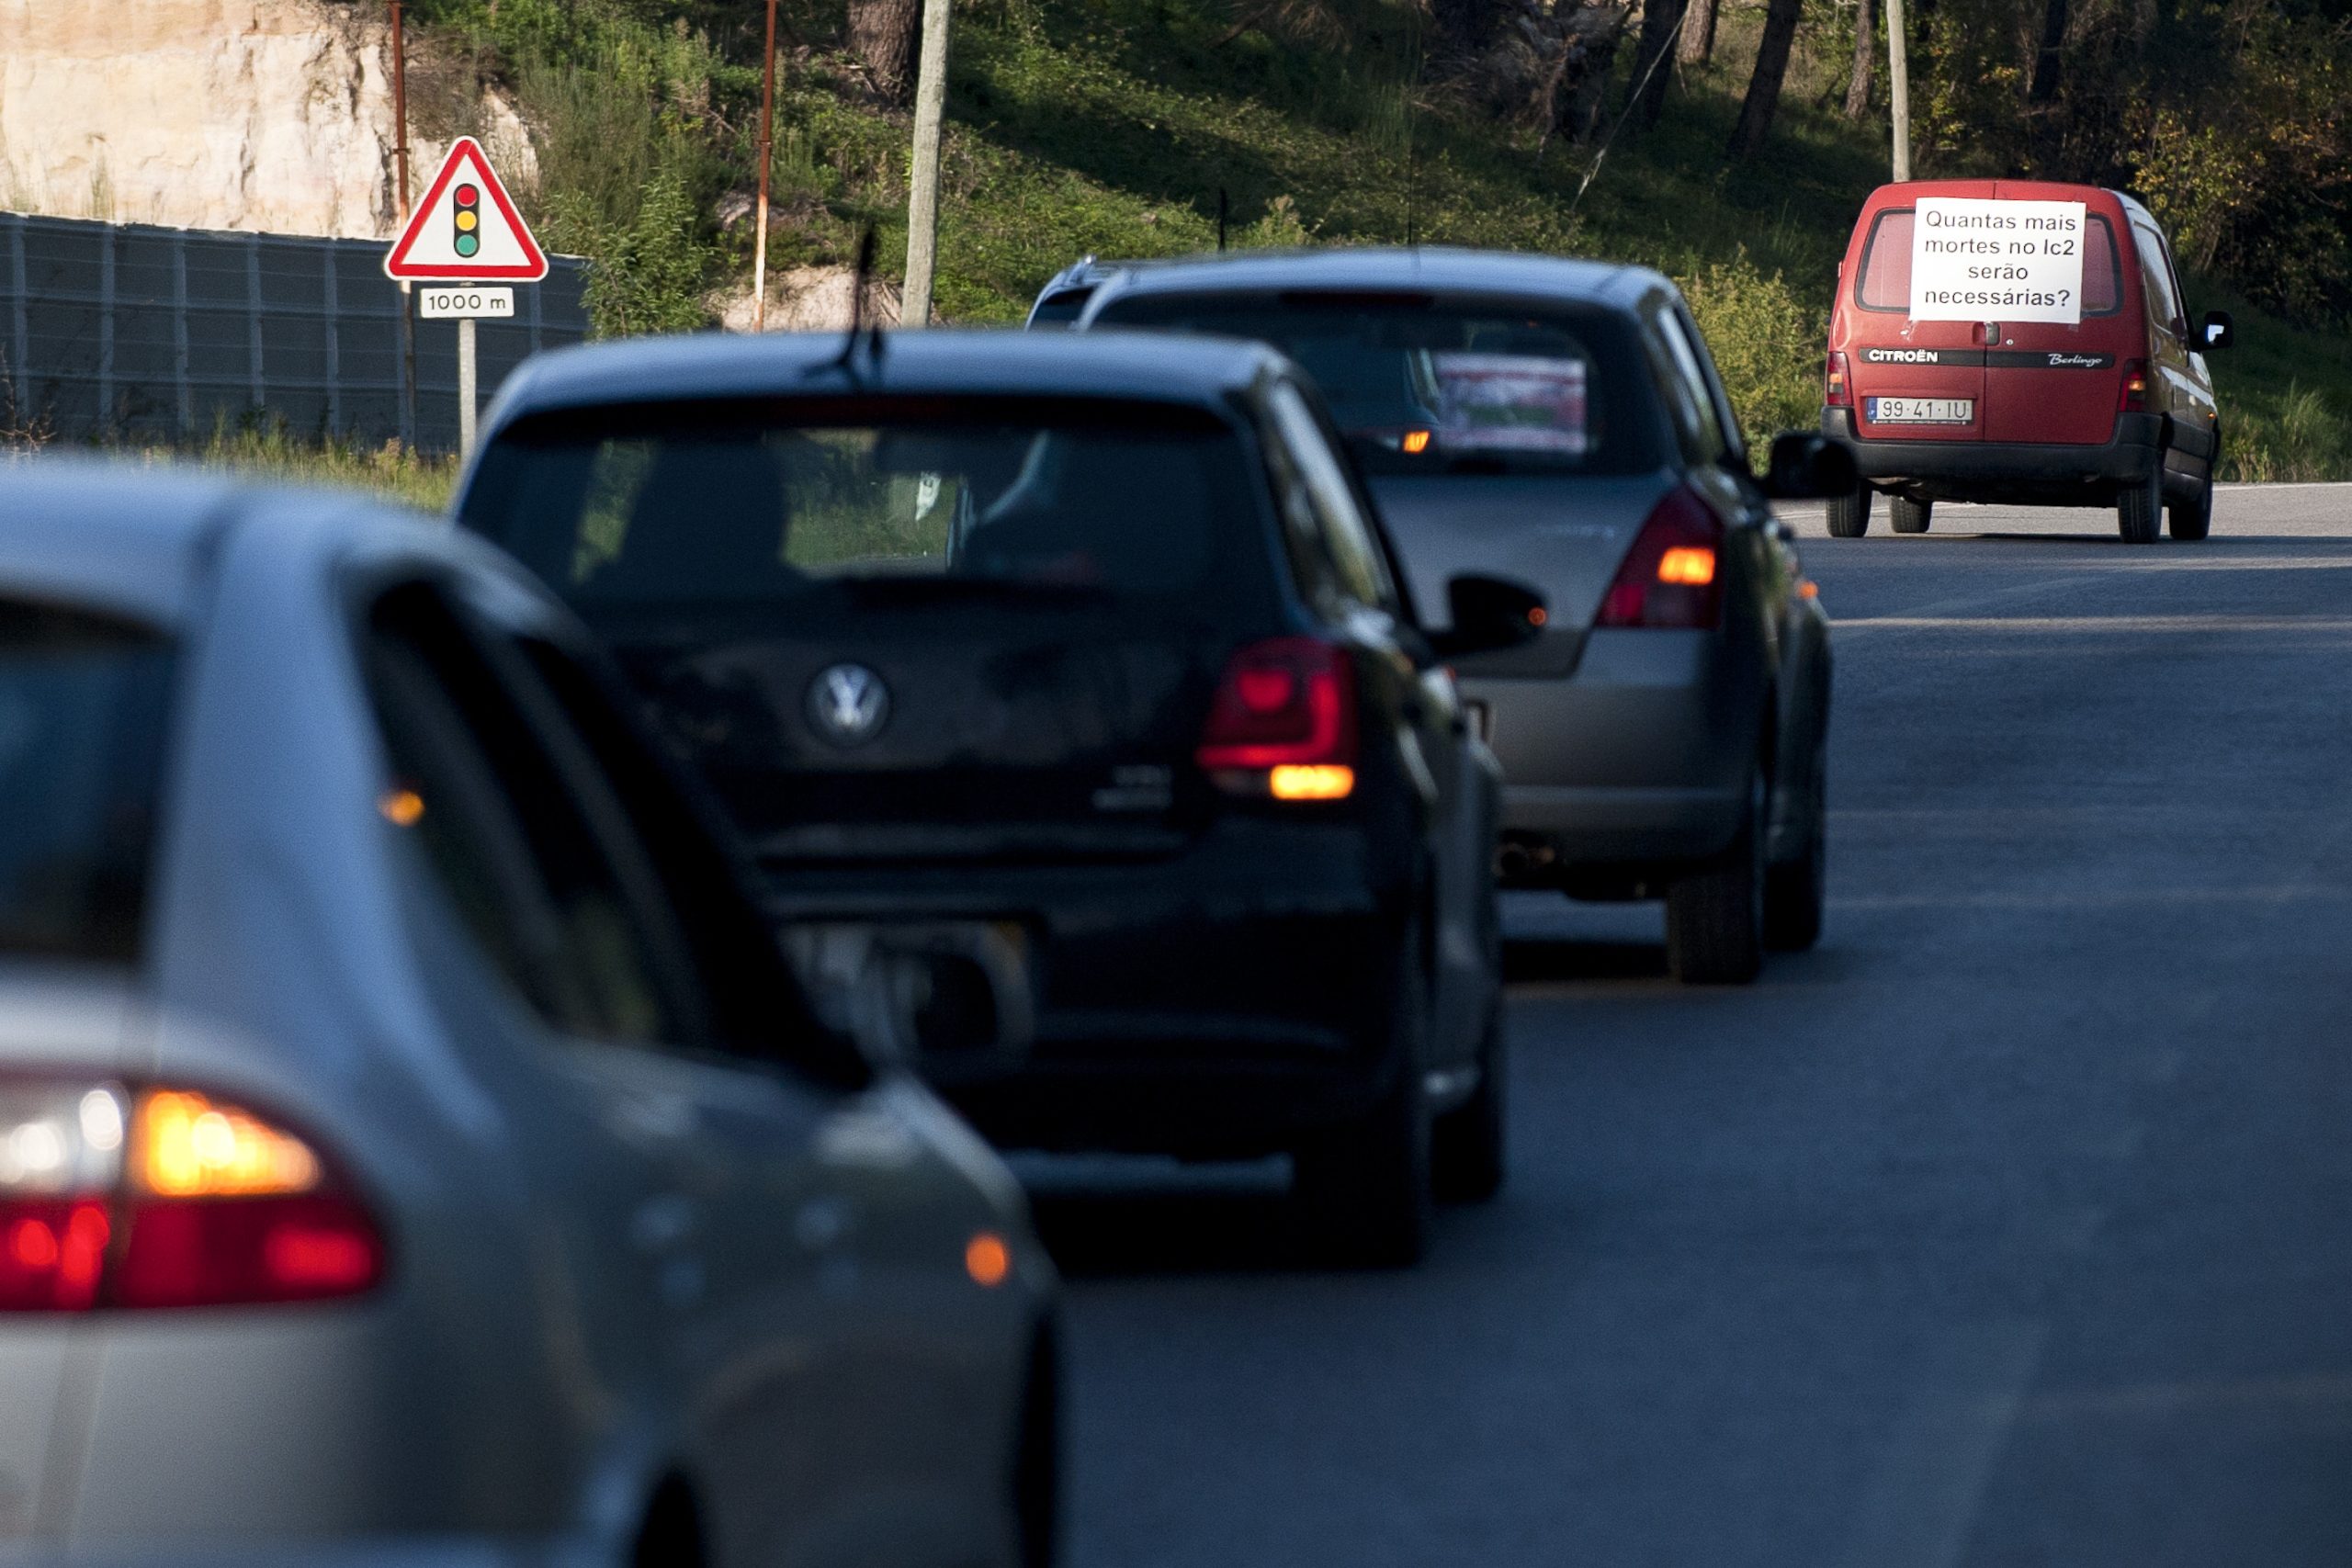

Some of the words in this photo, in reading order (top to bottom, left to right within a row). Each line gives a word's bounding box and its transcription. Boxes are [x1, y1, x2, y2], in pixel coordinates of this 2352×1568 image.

[1926, 210, 2017, 229] Quantas
[2026, 214, 2076, 231] mais
[1925, 239, 2000, 254] mortes
[2009, 242, 2035, 254] no
[1968, 263, 2029, 279] serão
[428, 294, 481, 310] 1000
[490, 299, 506, 310] m
[1925, 288, 2071, 307] necessárias?
[1868, 349, 1939, 363] CITROËN
[2047, 353, 2103, 367] Berlingo
